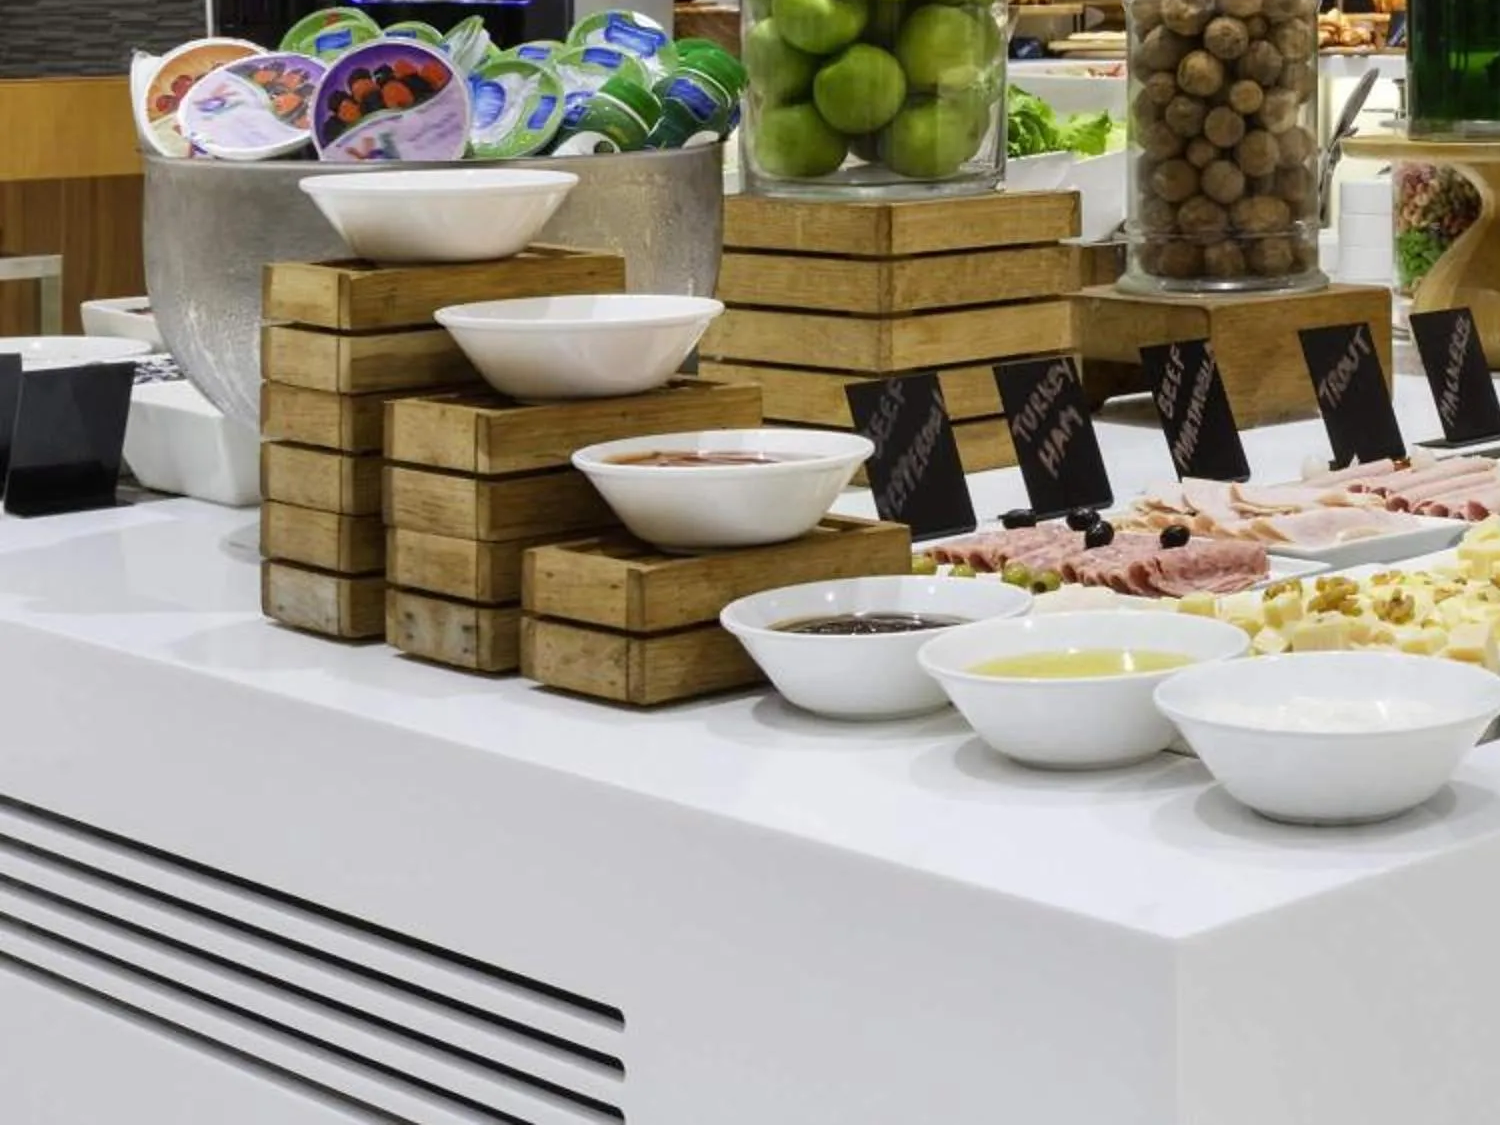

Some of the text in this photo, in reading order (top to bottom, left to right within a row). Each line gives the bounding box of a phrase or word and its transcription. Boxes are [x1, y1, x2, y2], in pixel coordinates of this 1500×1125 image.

[1012, 356, 1076, 443] TURKEY
[1158, 343, 1185, 419] BEEF
[1318, 326, 1373, 409] TROUT
[1038, 404, 1084, 476] HAM
